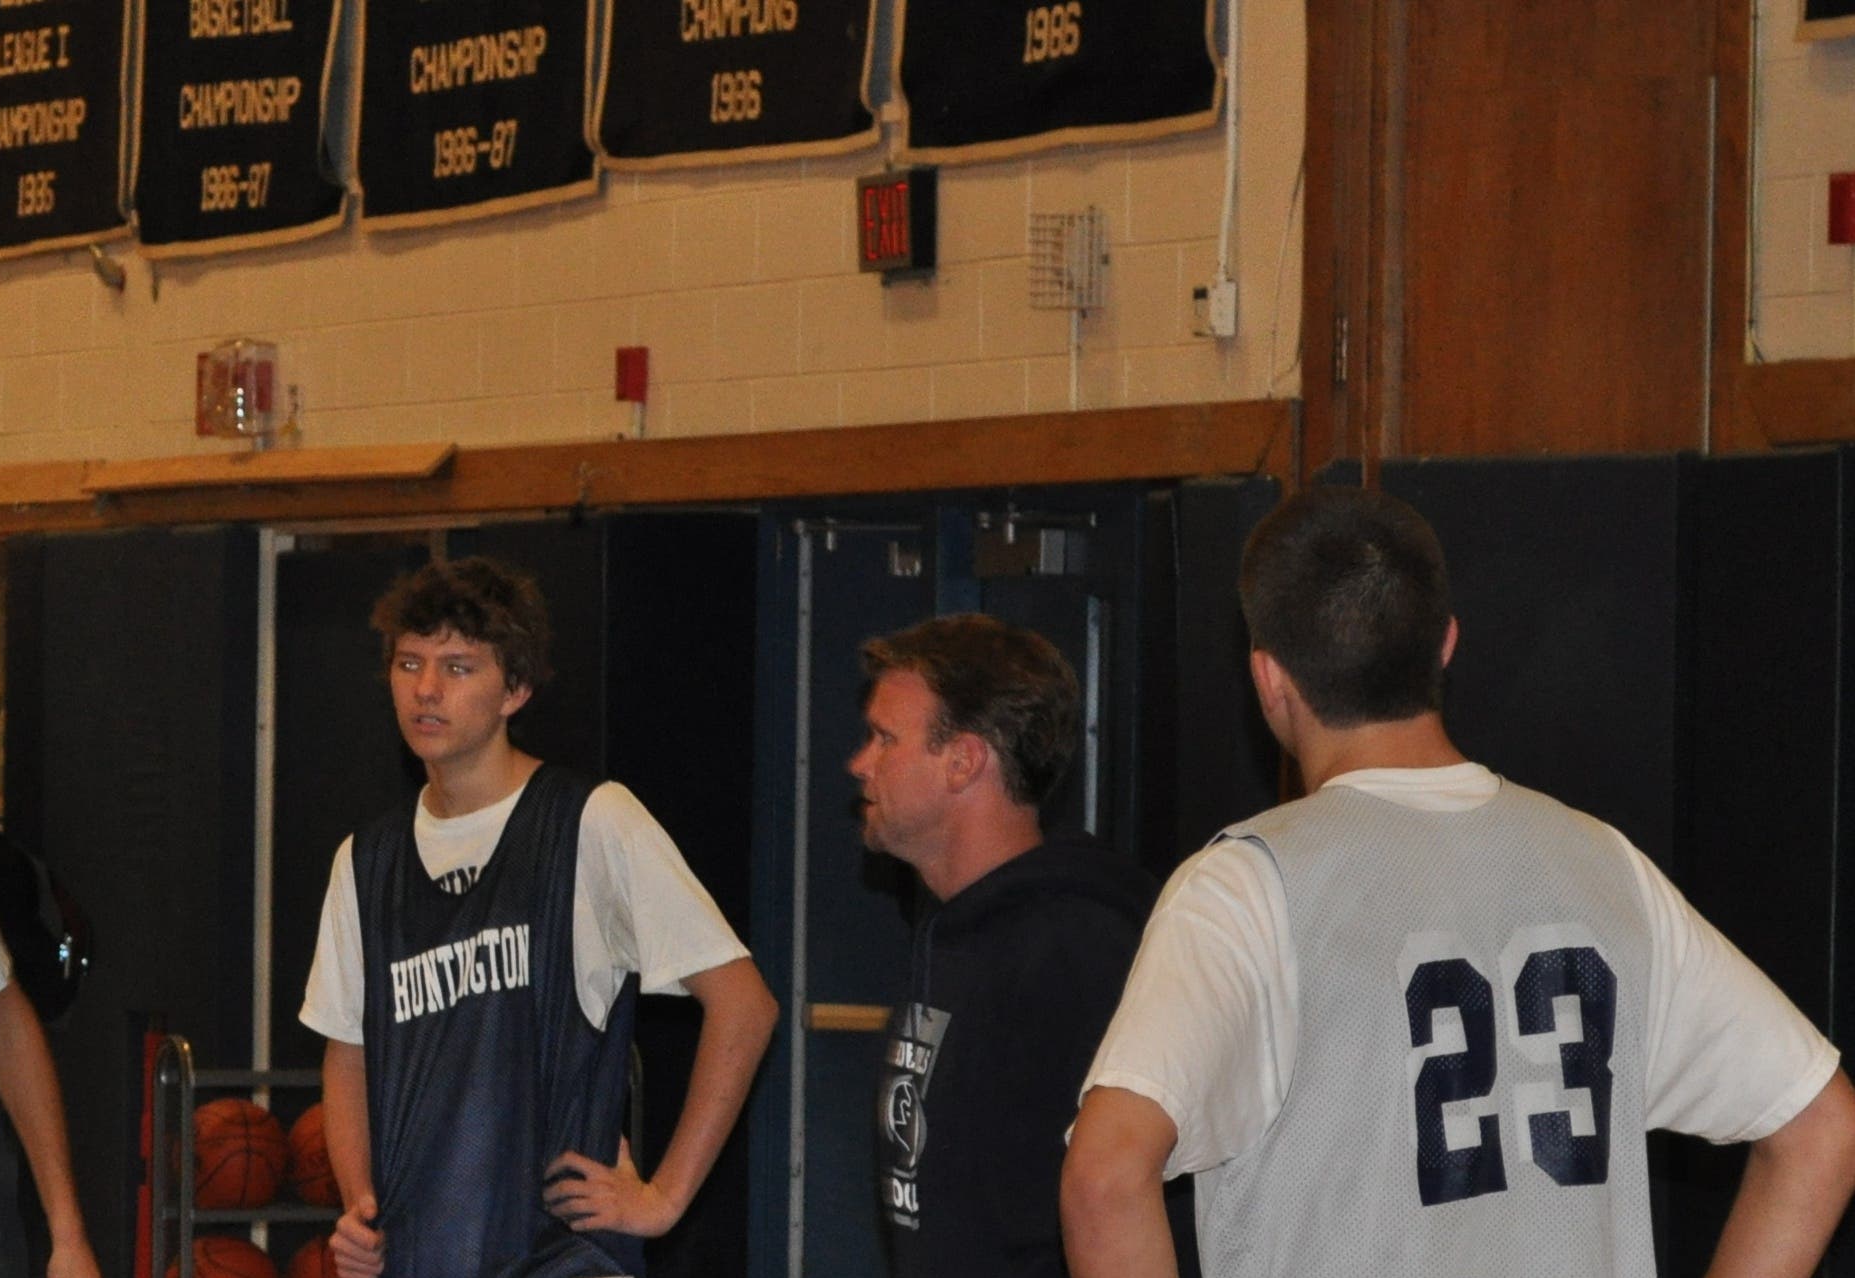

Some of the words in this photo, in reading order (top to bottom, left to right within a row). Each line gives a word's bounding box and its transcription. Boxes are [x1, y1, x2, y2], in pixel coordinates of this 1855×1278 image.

[409, 24, 549, 95] CHAMPIONSHIP
[1022, 1, 1084, 64] 1986
[178, 75, 303, 131] CHAMPIONSHIP
[709, 69, 764, 123] 1986
[431, 118, 520, 180] 1986-87
[1404, 946, 1618, 1207] 23
